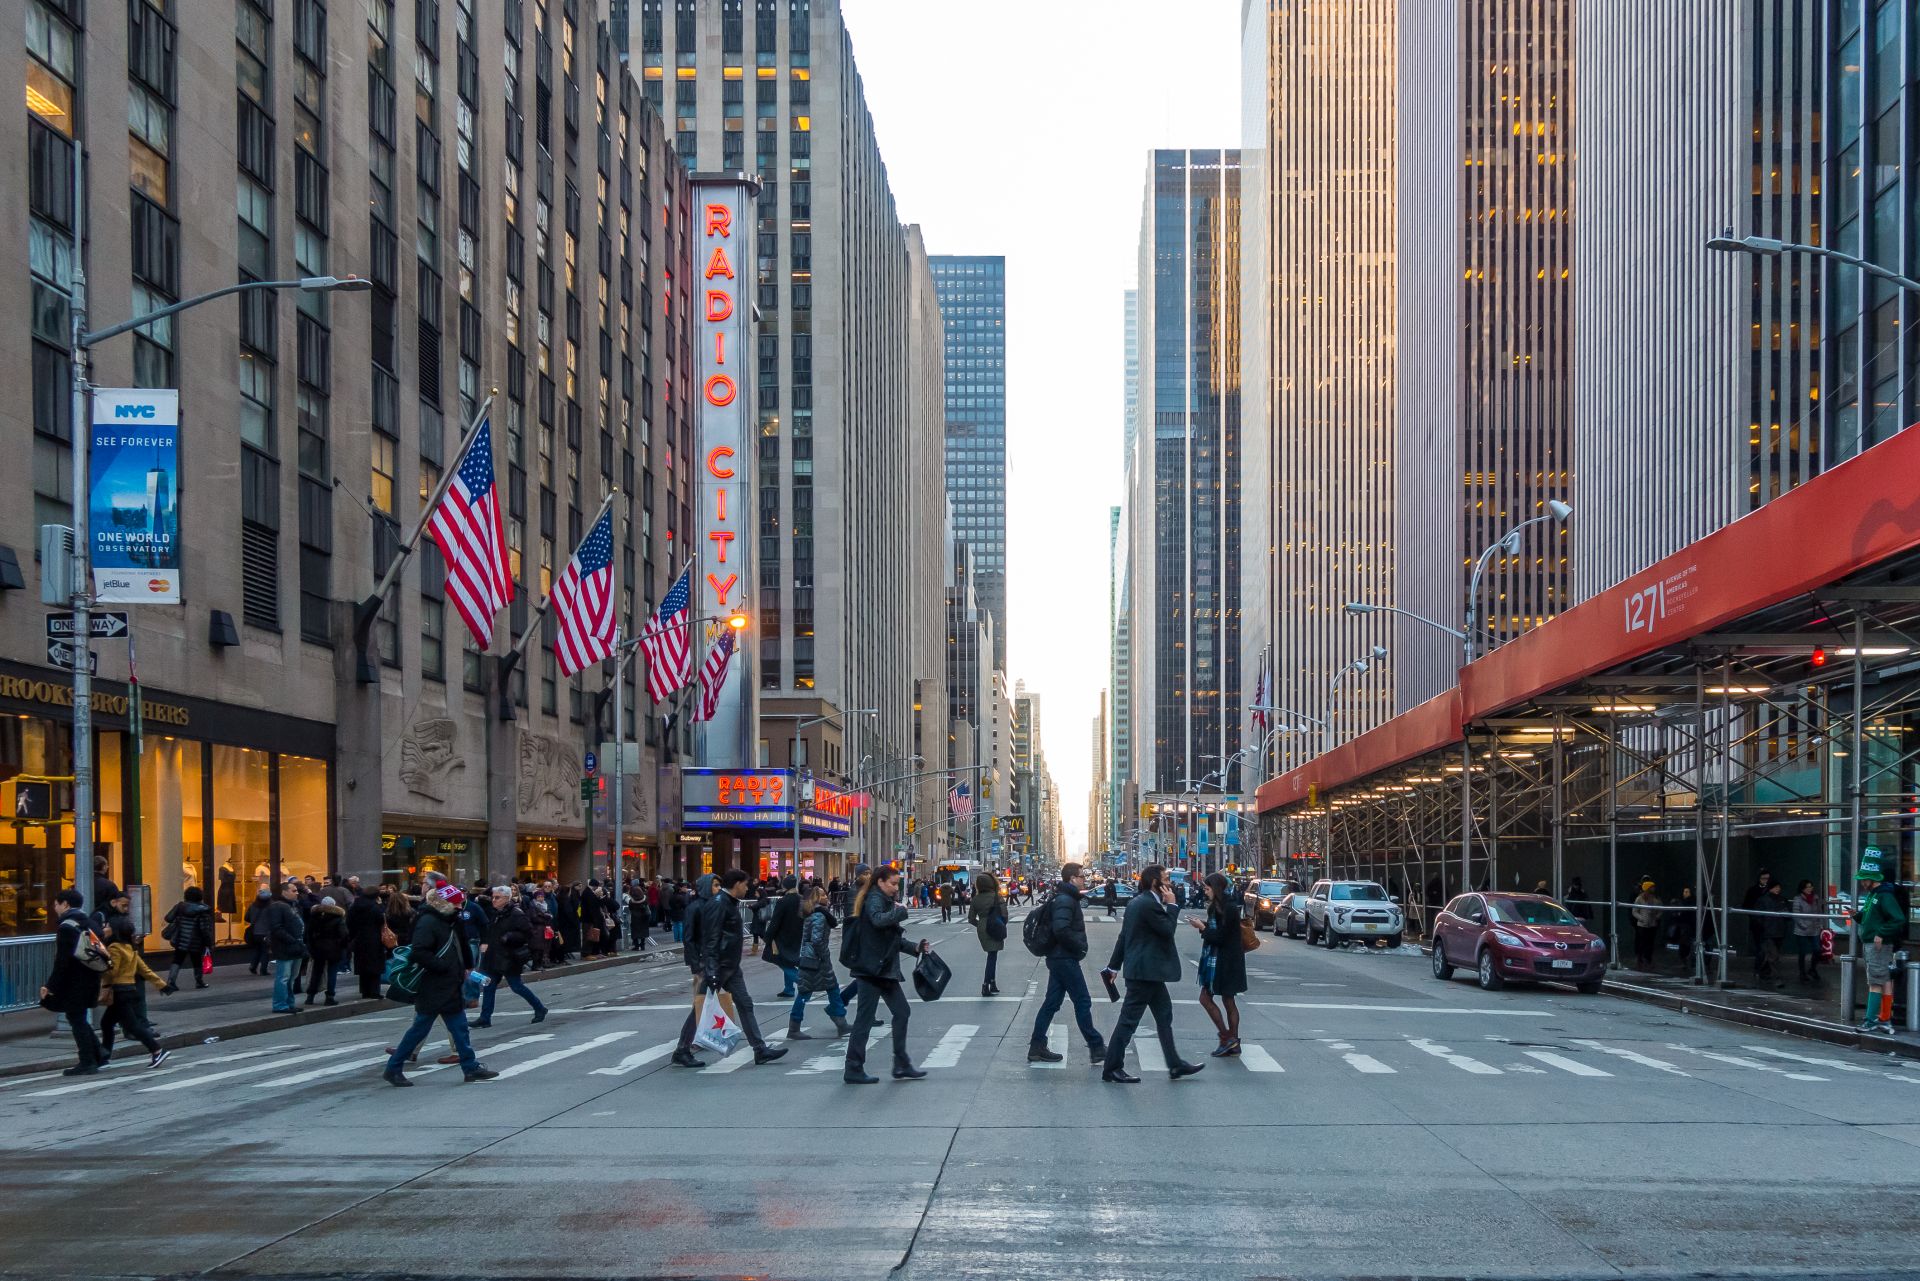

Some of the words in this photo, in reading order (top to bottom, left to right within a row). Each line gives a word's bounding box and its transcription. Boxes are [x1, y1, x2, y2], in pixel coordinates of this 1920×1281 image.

[704, 203, 737, 406] RADIO
[115, 405, 155, 418] NYC
[96, 437, 116, 446] SEE
[121, 437, 173, 447] FOREVER
[707, 445, 738, 605] CITY
[98, 532, 123, 542] ONE
[125, 532, 170, 543] WORLD
[98, 545, 170, 553] OBSERVATORY
[103, 579, 130, 589] jetBlue
[1666, 580, 1688, 595] AMERICAS
[1625, 581, 1666, 633] 1271
[1667, 603, 1685, 616] CENTER
[53, 620, 75, 631] ONE
[90, 620, 117, 630] WAY
[53, 648, 70, 659] ONE
[0, 674, 74, 706] ROOKS
[90, 691, 190, 726] BROHERS
[718, 776, 784, 790] RADIO
[718, 790, 783, 805] CITY
[754, 812, 785, 821] HALL
